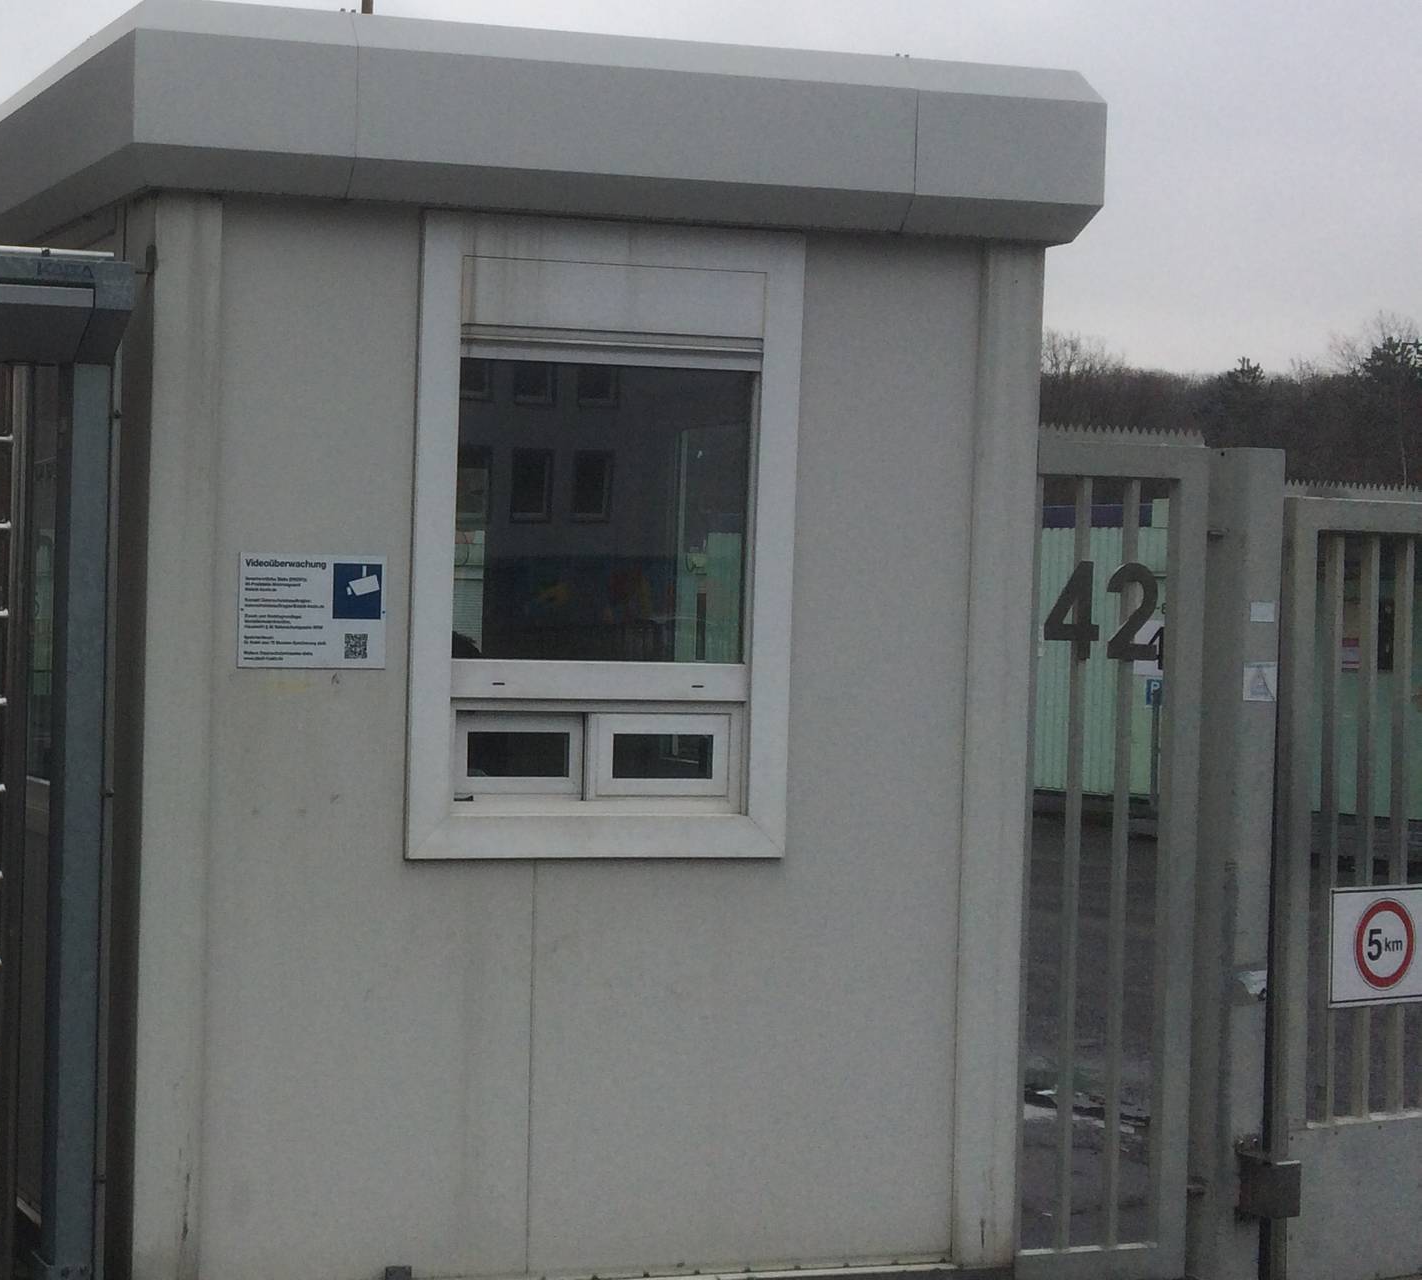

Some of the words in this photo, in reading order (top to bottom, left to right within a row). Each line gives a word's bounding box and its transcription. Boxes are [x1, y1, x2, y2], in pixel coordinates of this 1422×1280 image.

[245, 558, 327, 570] Videoüberwachung
[1044, 560, 1158, 661] 42
[1367, 928, 1383, 961] 5
[1384, 937, 1403, 952] km
